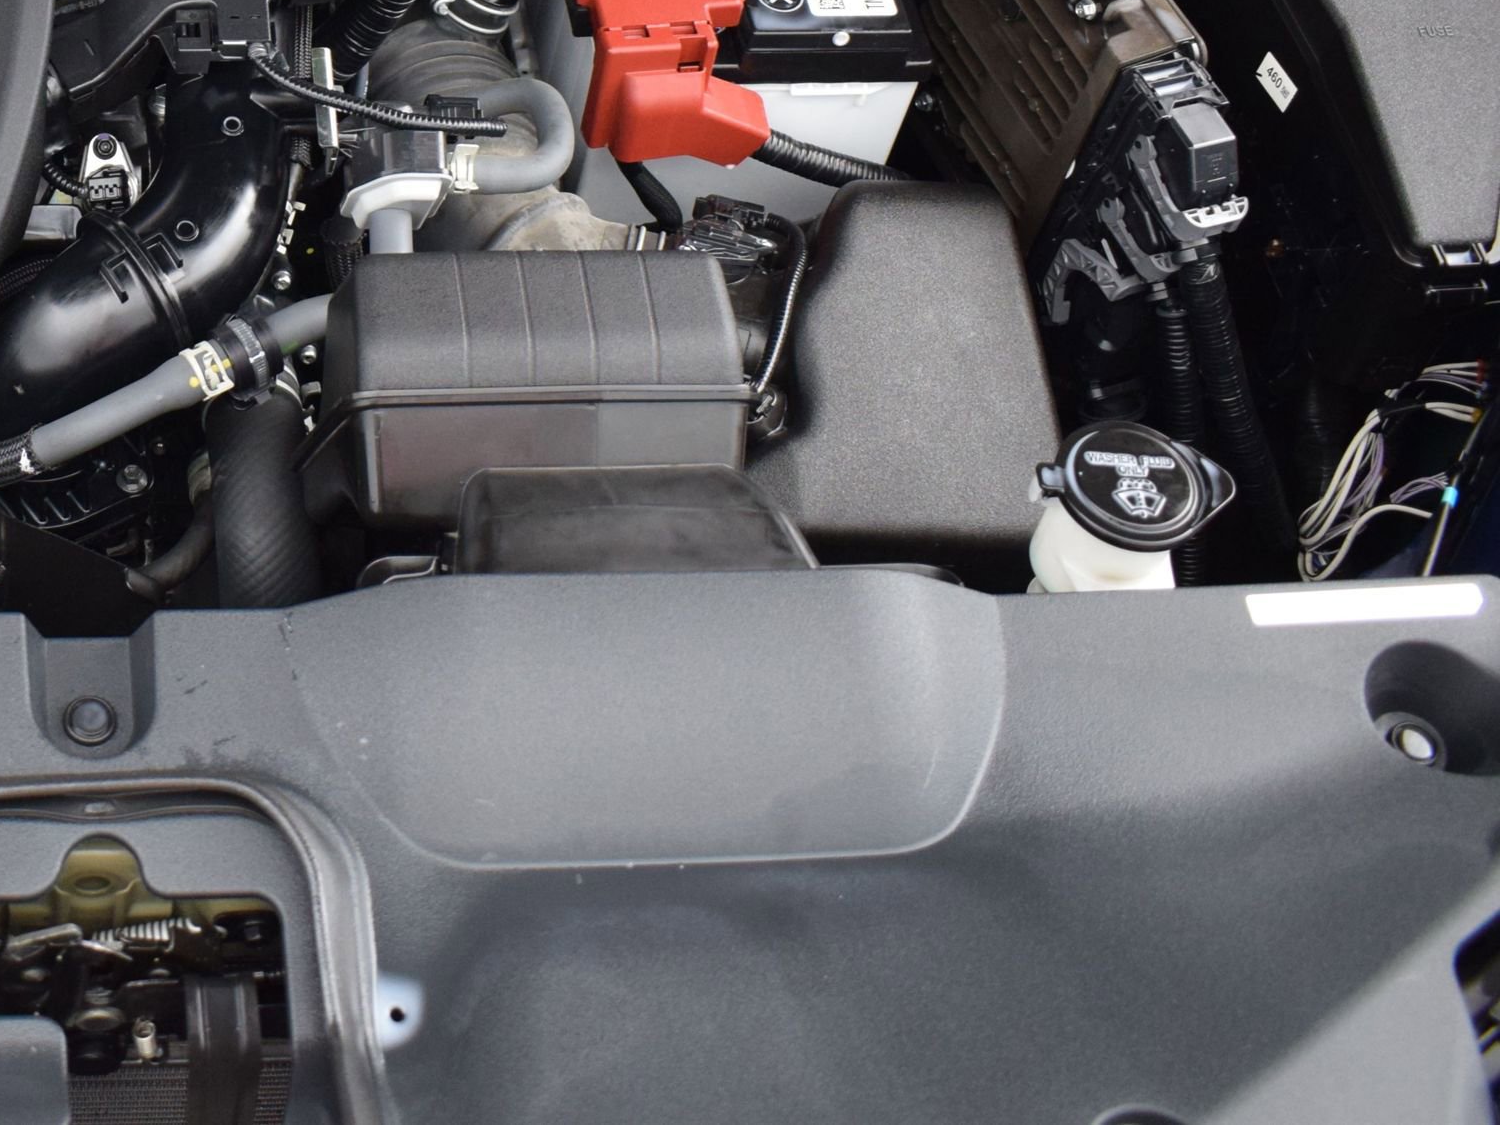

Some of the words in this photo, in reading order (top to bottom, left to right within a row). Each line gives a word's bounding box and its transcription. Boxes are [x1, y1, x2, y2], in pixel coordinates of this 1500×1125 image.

[1417, 25, 1454, 38] FUSE
[1266, 67, 1283, 89] 460
[1086, 452, 1137, 465] WASHER
[1140, 455, 1173, 468] FLUID
[1118, 465, 1148, 476] ONLY
